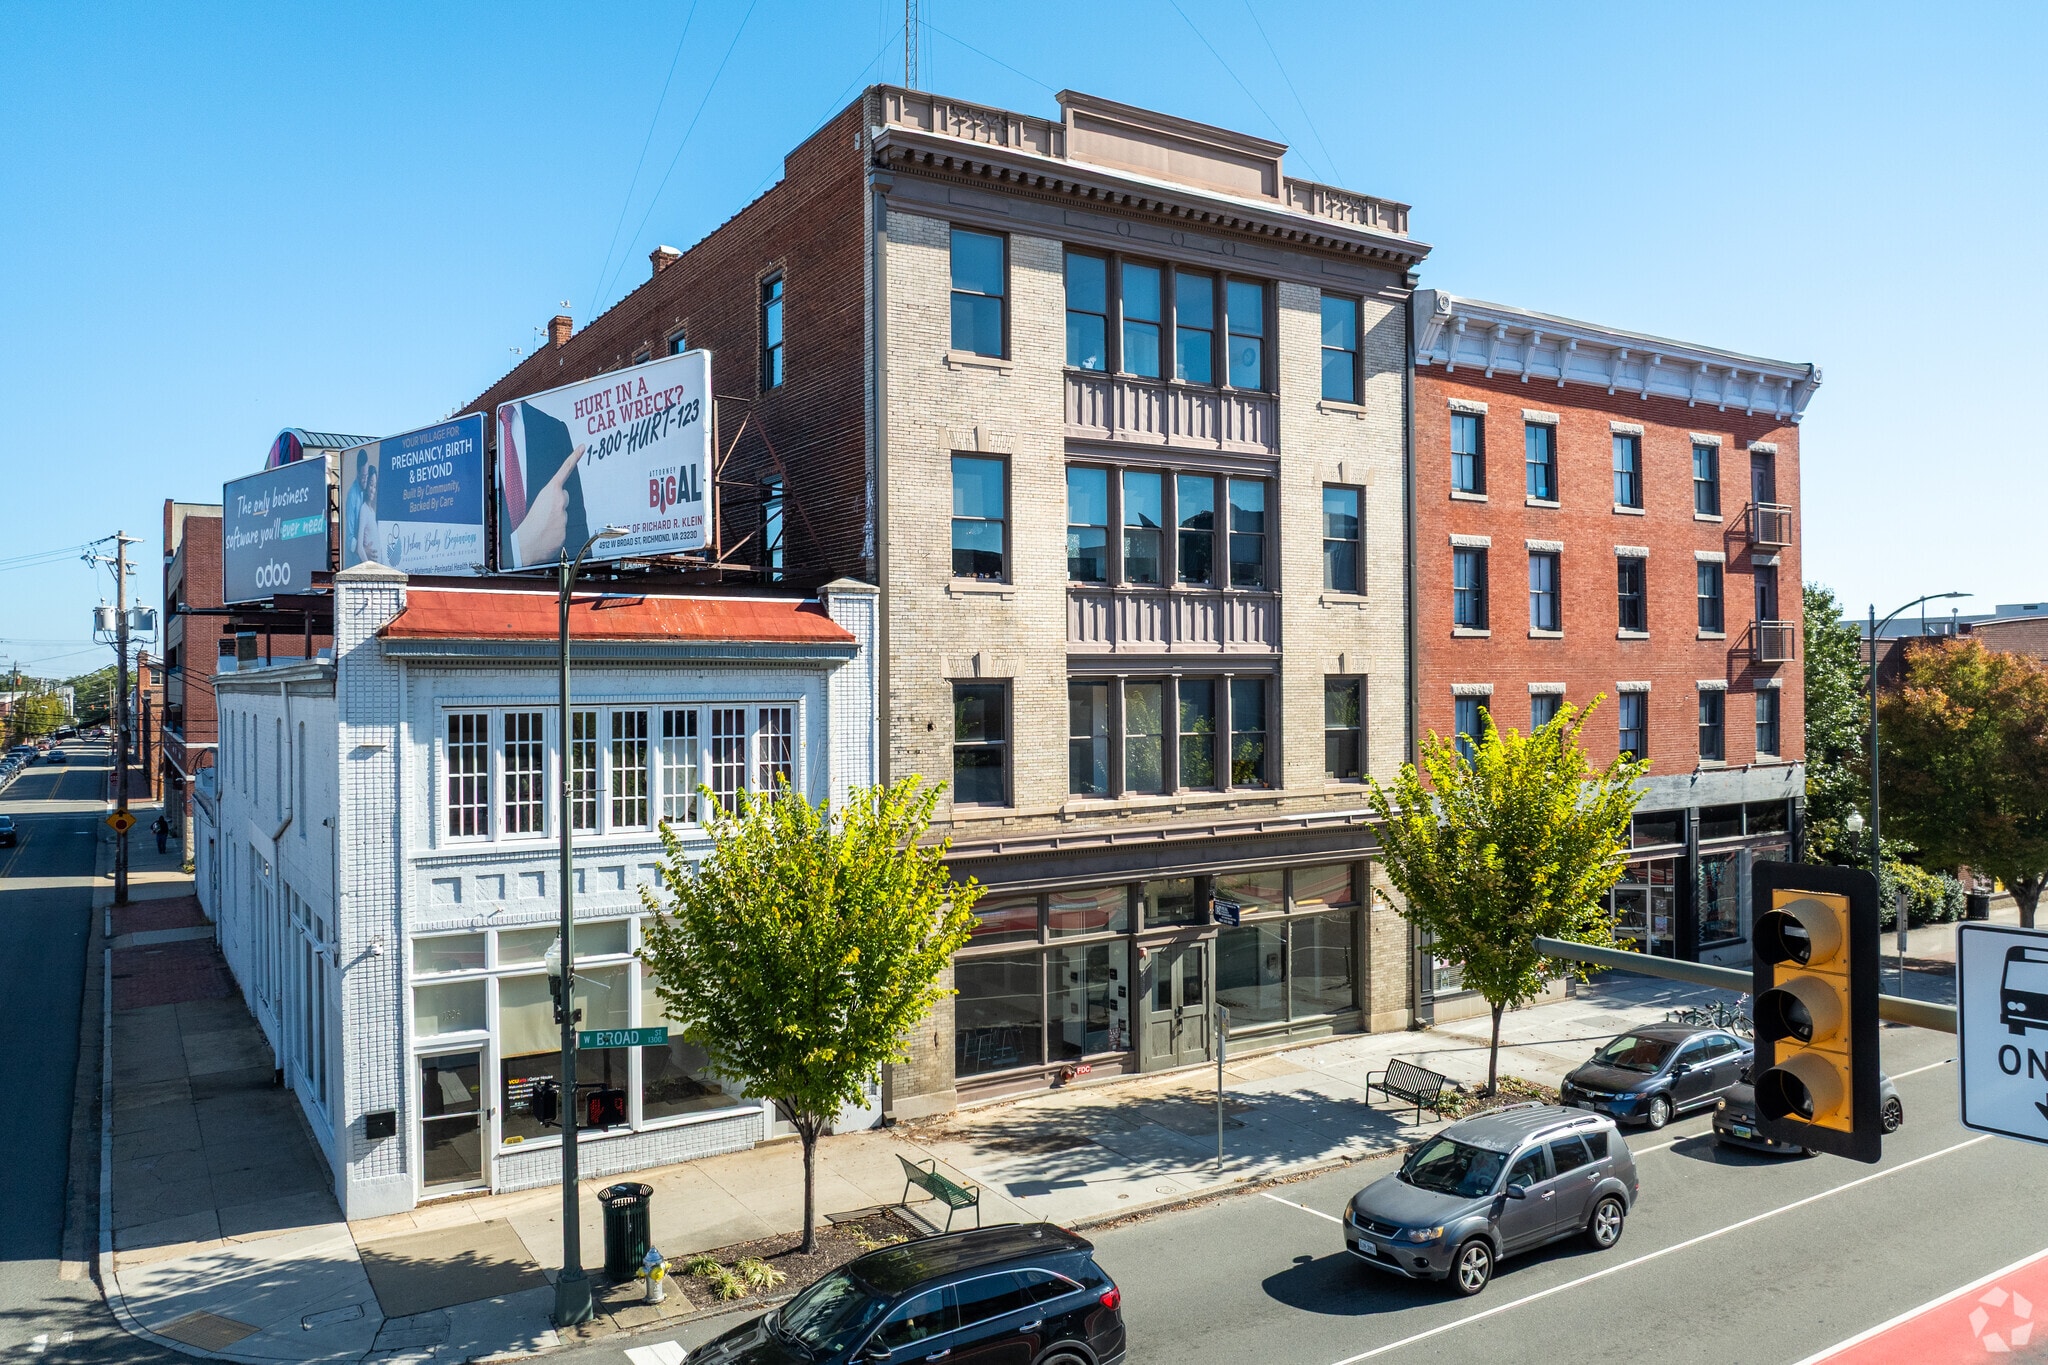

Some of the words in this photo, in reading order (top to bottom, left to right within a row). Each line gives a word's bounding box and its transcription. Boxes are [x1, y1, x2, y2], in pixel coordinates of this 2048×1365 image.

[574, 388, 611, 420] HURT
[616, 380, 632, 405] IN
[637, 376, 649, 395] A
[587, 410, 616, 435] CAR
[620, 384, 684, 424] WRECK?
[402, 436, 419, 449] YOUR
[420, 430, 445, 445] VILLAGE
[446, 425, 460, 439] FOR
[587, 398, 700, 466] 1-800-HURT-123
[391, 443, 444, 471] PREGNANCY,
[445, 437, 473, 458] BIRTH
[409, 470, 415, 484] &
[416, 461, 453, 482] BEYOND
[649, 466, 676, 478] ATTORNEY
[403, 486, 416, 500] Built
[417, 485, 424, 498] By
[425, 481, 460, 497] Community,
[237, 494, 252, 519] The
[253, 490, 270, 517] only
[272, 486, 310, 508] business
[409, 499, 431, 513] Backed
[431, 498, 439, 512] By
[439, 496, 454, 509] Care
[225, 526, 259, 551] software
[259, 518, 281, 549] you'll
[282, 523, 300, 538] ever
[303, 509, 325, 533] need
[632, 523, 641, 533] OF
[642, 518, 671, 532] RICHARD
[673, 517, 680, 528] R.
[681, 515, 703, 527] KLEIN
[617, 539, 633, 548] BROAD
[672, 532, 679, 540] VA
[680, 530, 698, 541] 23230
[255, 558, 291, 589] odoo
[584, 1036, 590, 1044] W
[597, 1031, 639, 1046] BROAD
[1077, 1065, 1091, 1074] FDC
